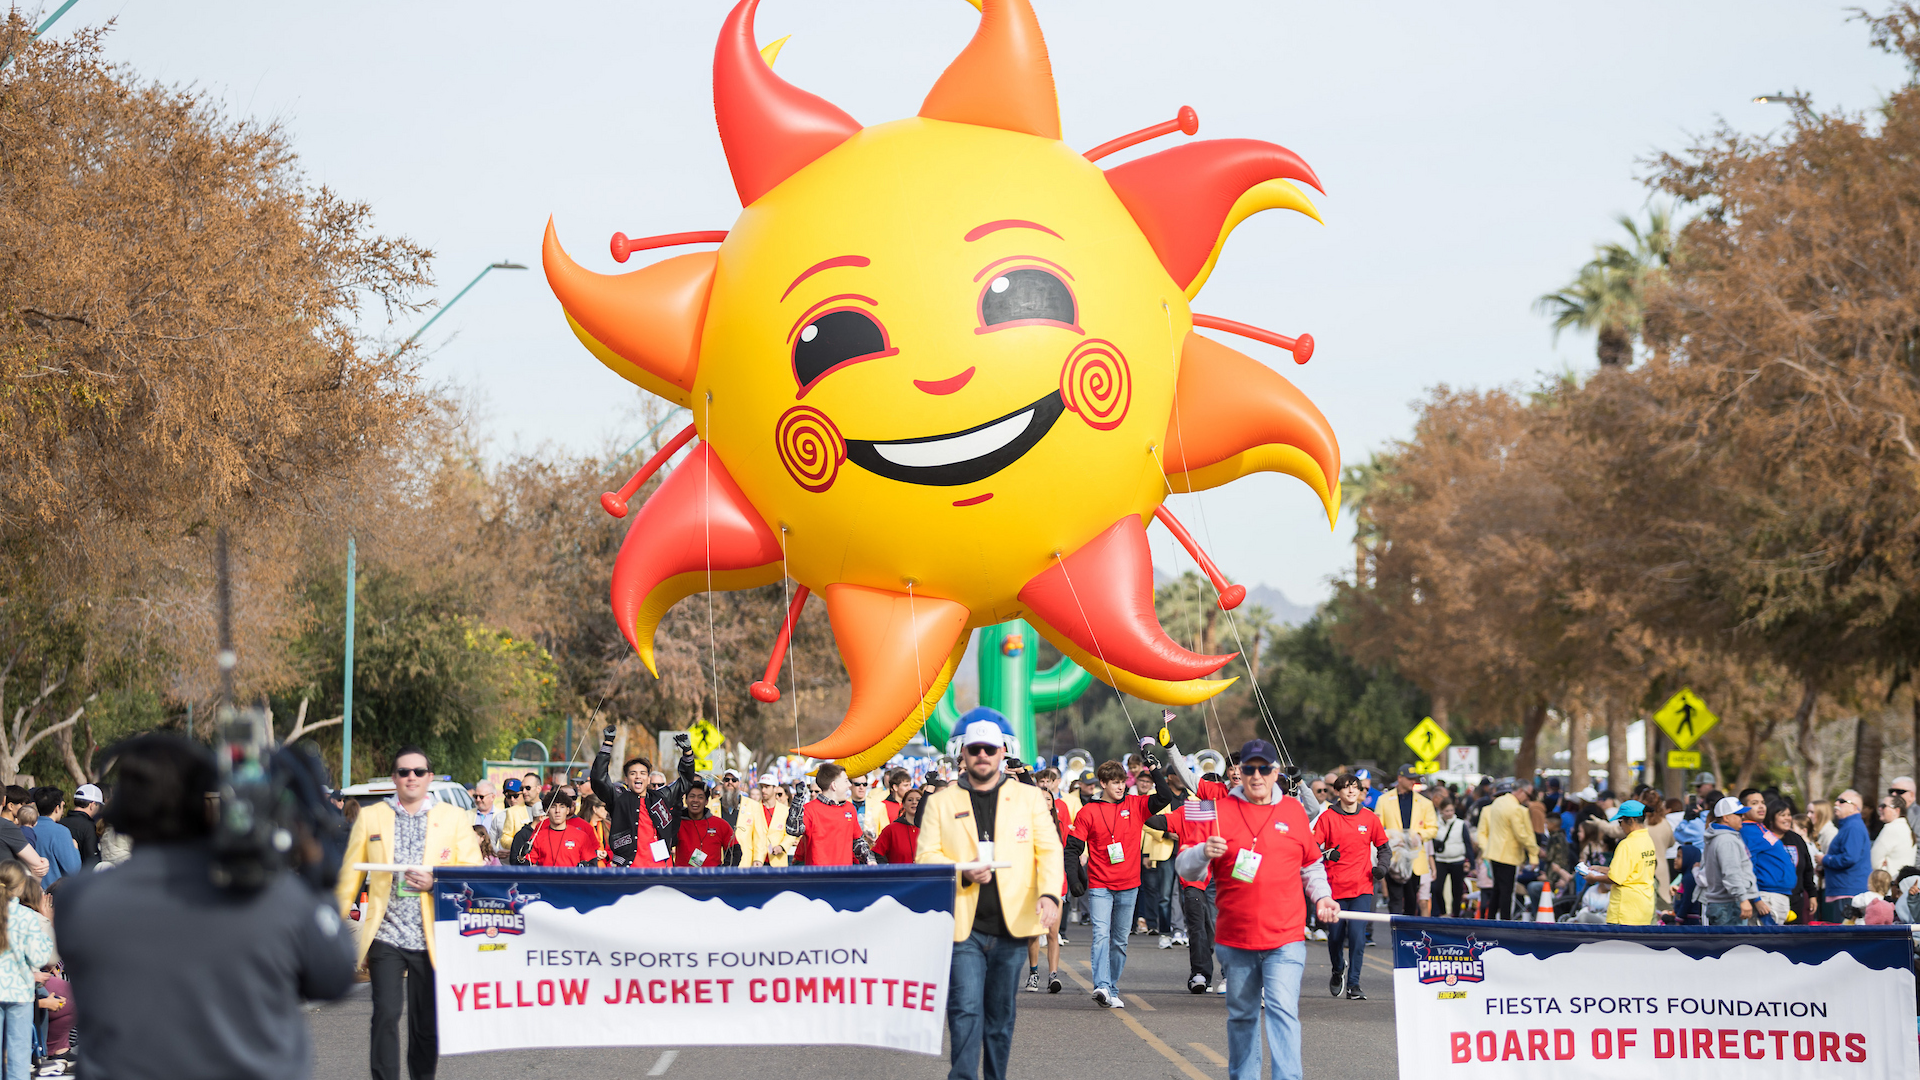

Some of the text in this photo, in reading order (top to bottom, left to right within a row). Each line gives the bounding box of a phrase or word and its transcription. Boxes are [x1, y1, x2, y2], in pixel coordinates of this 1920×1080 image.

[460, 913, 524, 931] PARADE
[527, 948, 868, 968] FIESTA SPORTS FOUNDATION
[1437, 947, 1464, 956] Vrbo
[1420, 961, 1483, 978] PARADE
[451, 977, 937, 1012] YELLOW JACKET COMMITTEE
[1487, 997, 1828, 1018] FIESTA SPORTS FOUNDATION
[1450, 1028, 1867, 1064] BOARD OF DIRECTORS
